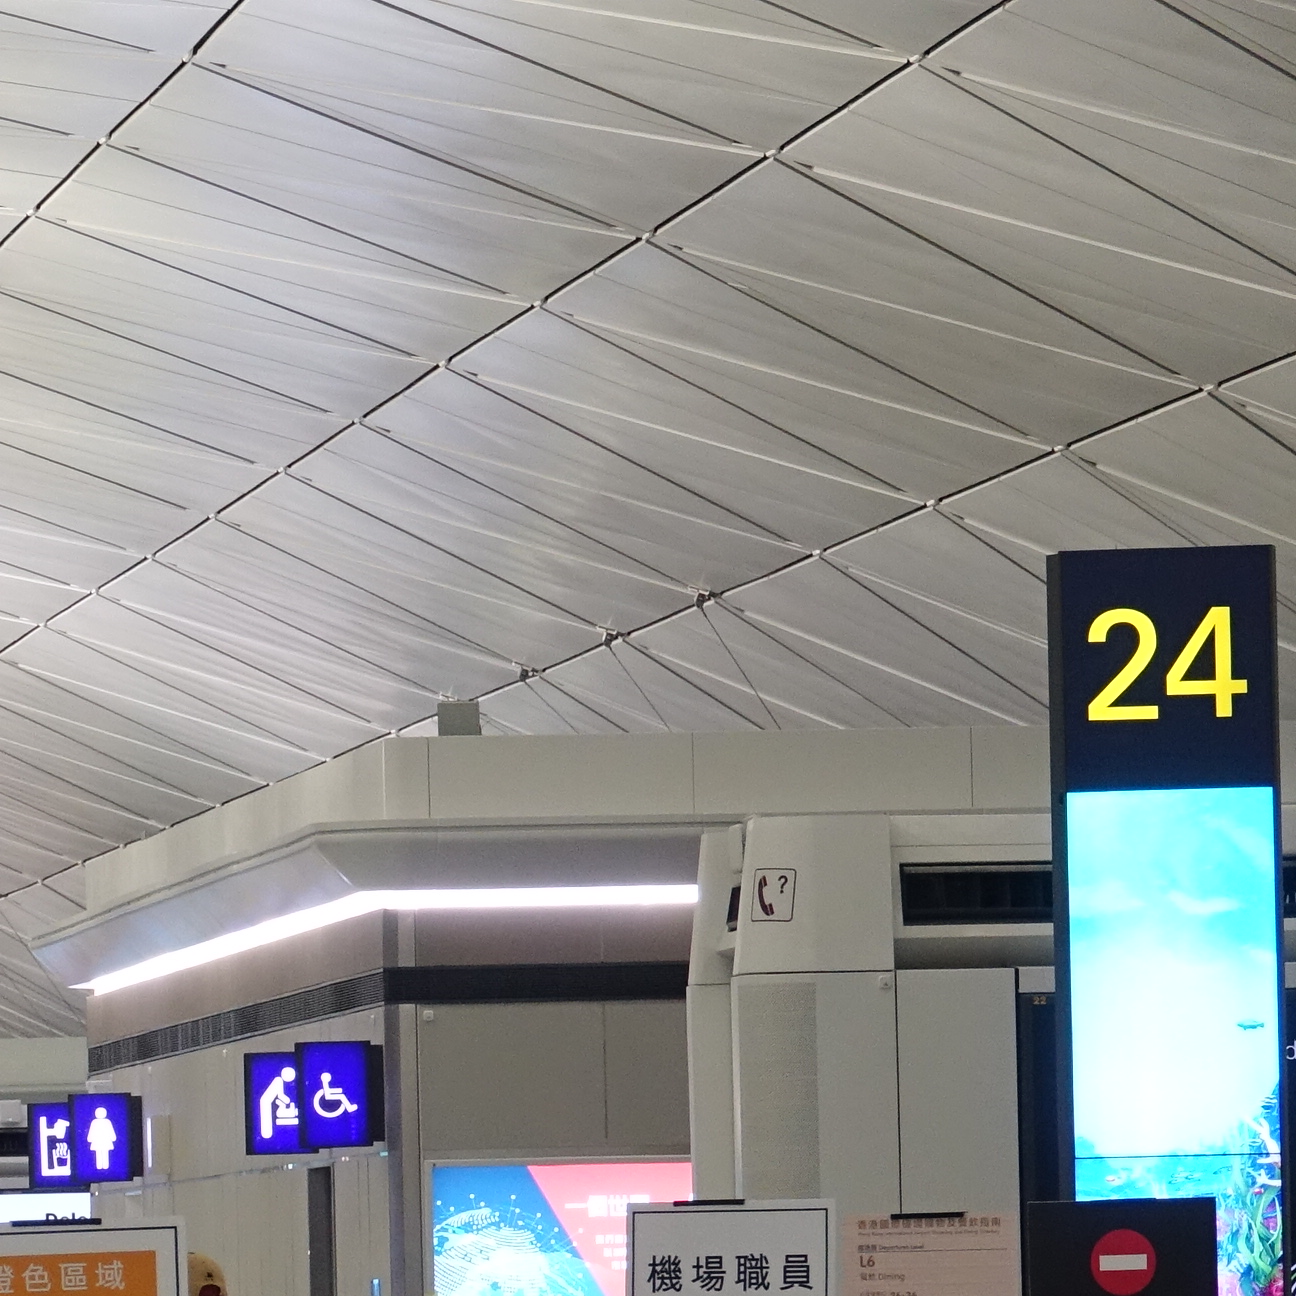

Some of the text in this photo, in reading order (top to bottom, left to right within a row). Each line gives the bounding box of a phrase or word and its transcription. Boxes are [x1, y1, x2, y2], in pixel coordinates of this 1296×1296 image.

[1087, 607, 1247, 721] 24
[647, 1253, 813, 1293] 機場職員
[859, 1255, 875, 1268] L6
